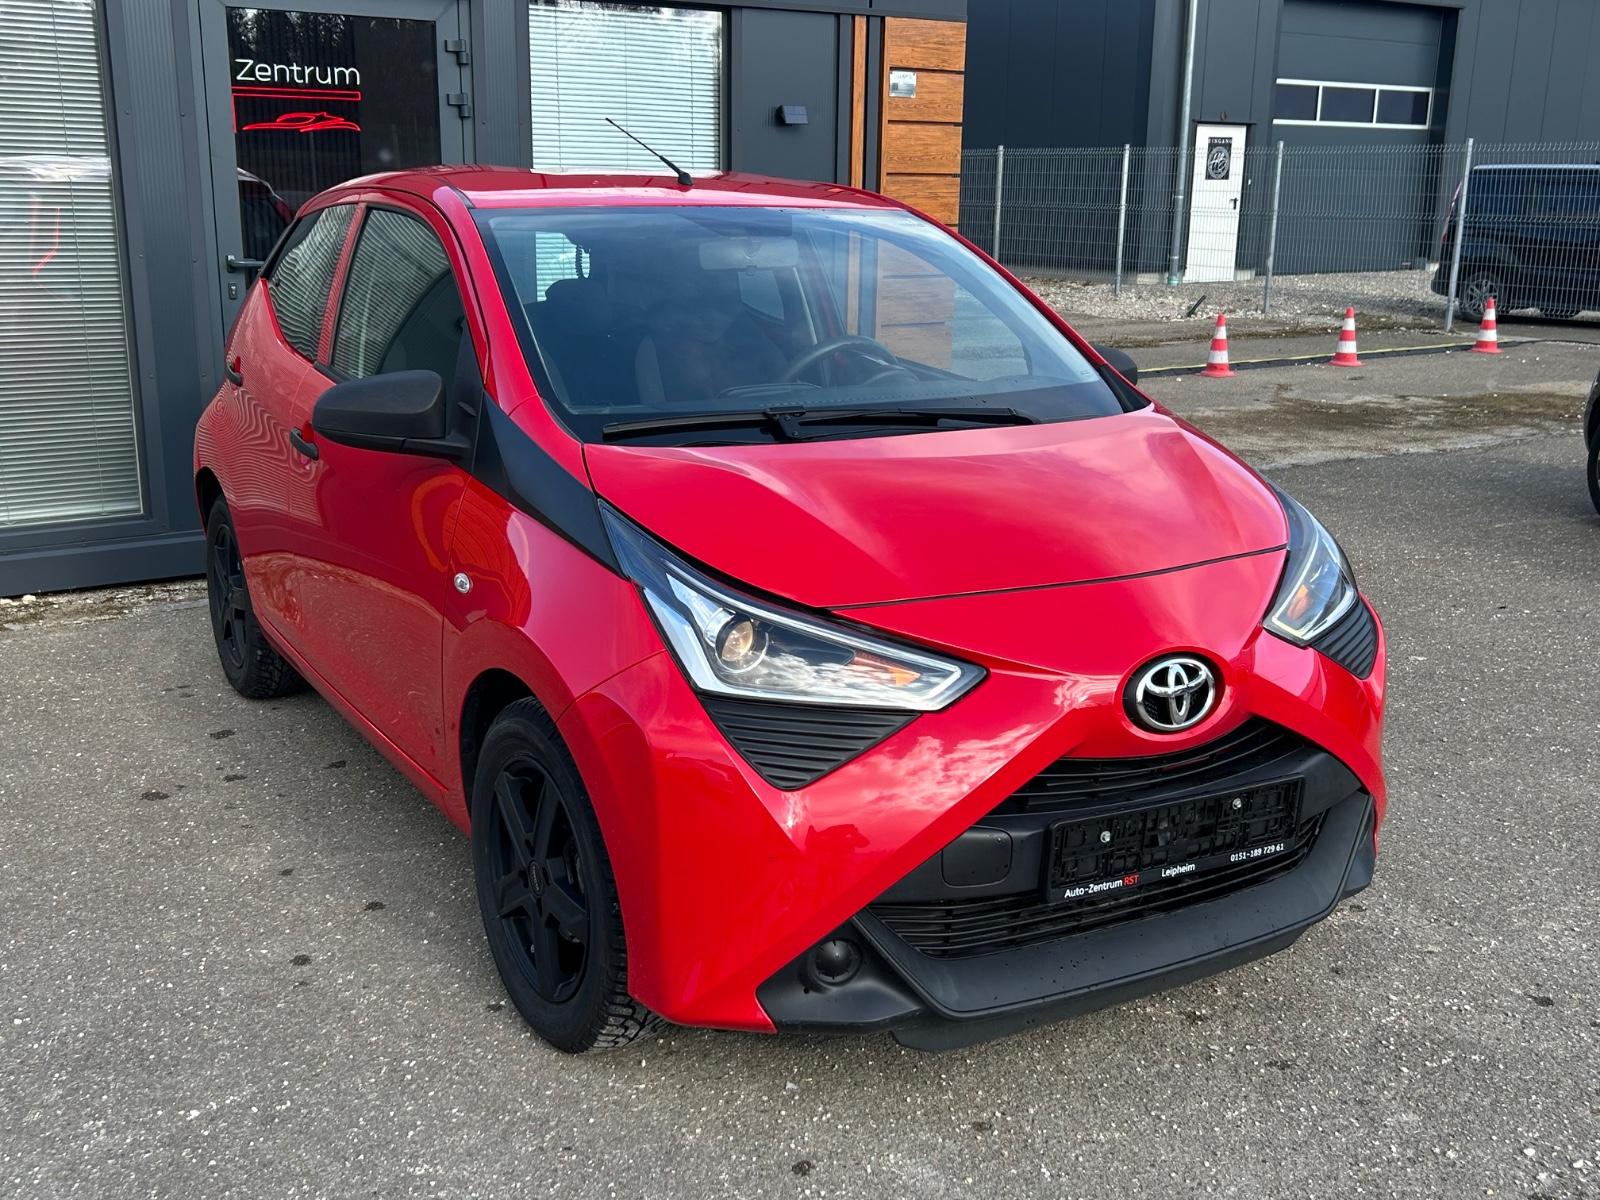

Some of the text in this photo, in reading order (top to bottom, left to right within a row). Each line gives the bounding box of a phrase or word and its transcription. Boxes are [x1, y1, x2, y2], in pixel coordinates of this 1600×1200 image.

[235, 58, 360, 85] Zentrum
[1064, 843, 1284, 899] Auto-Zentrum RST Leipheim 0151-189 729 61
